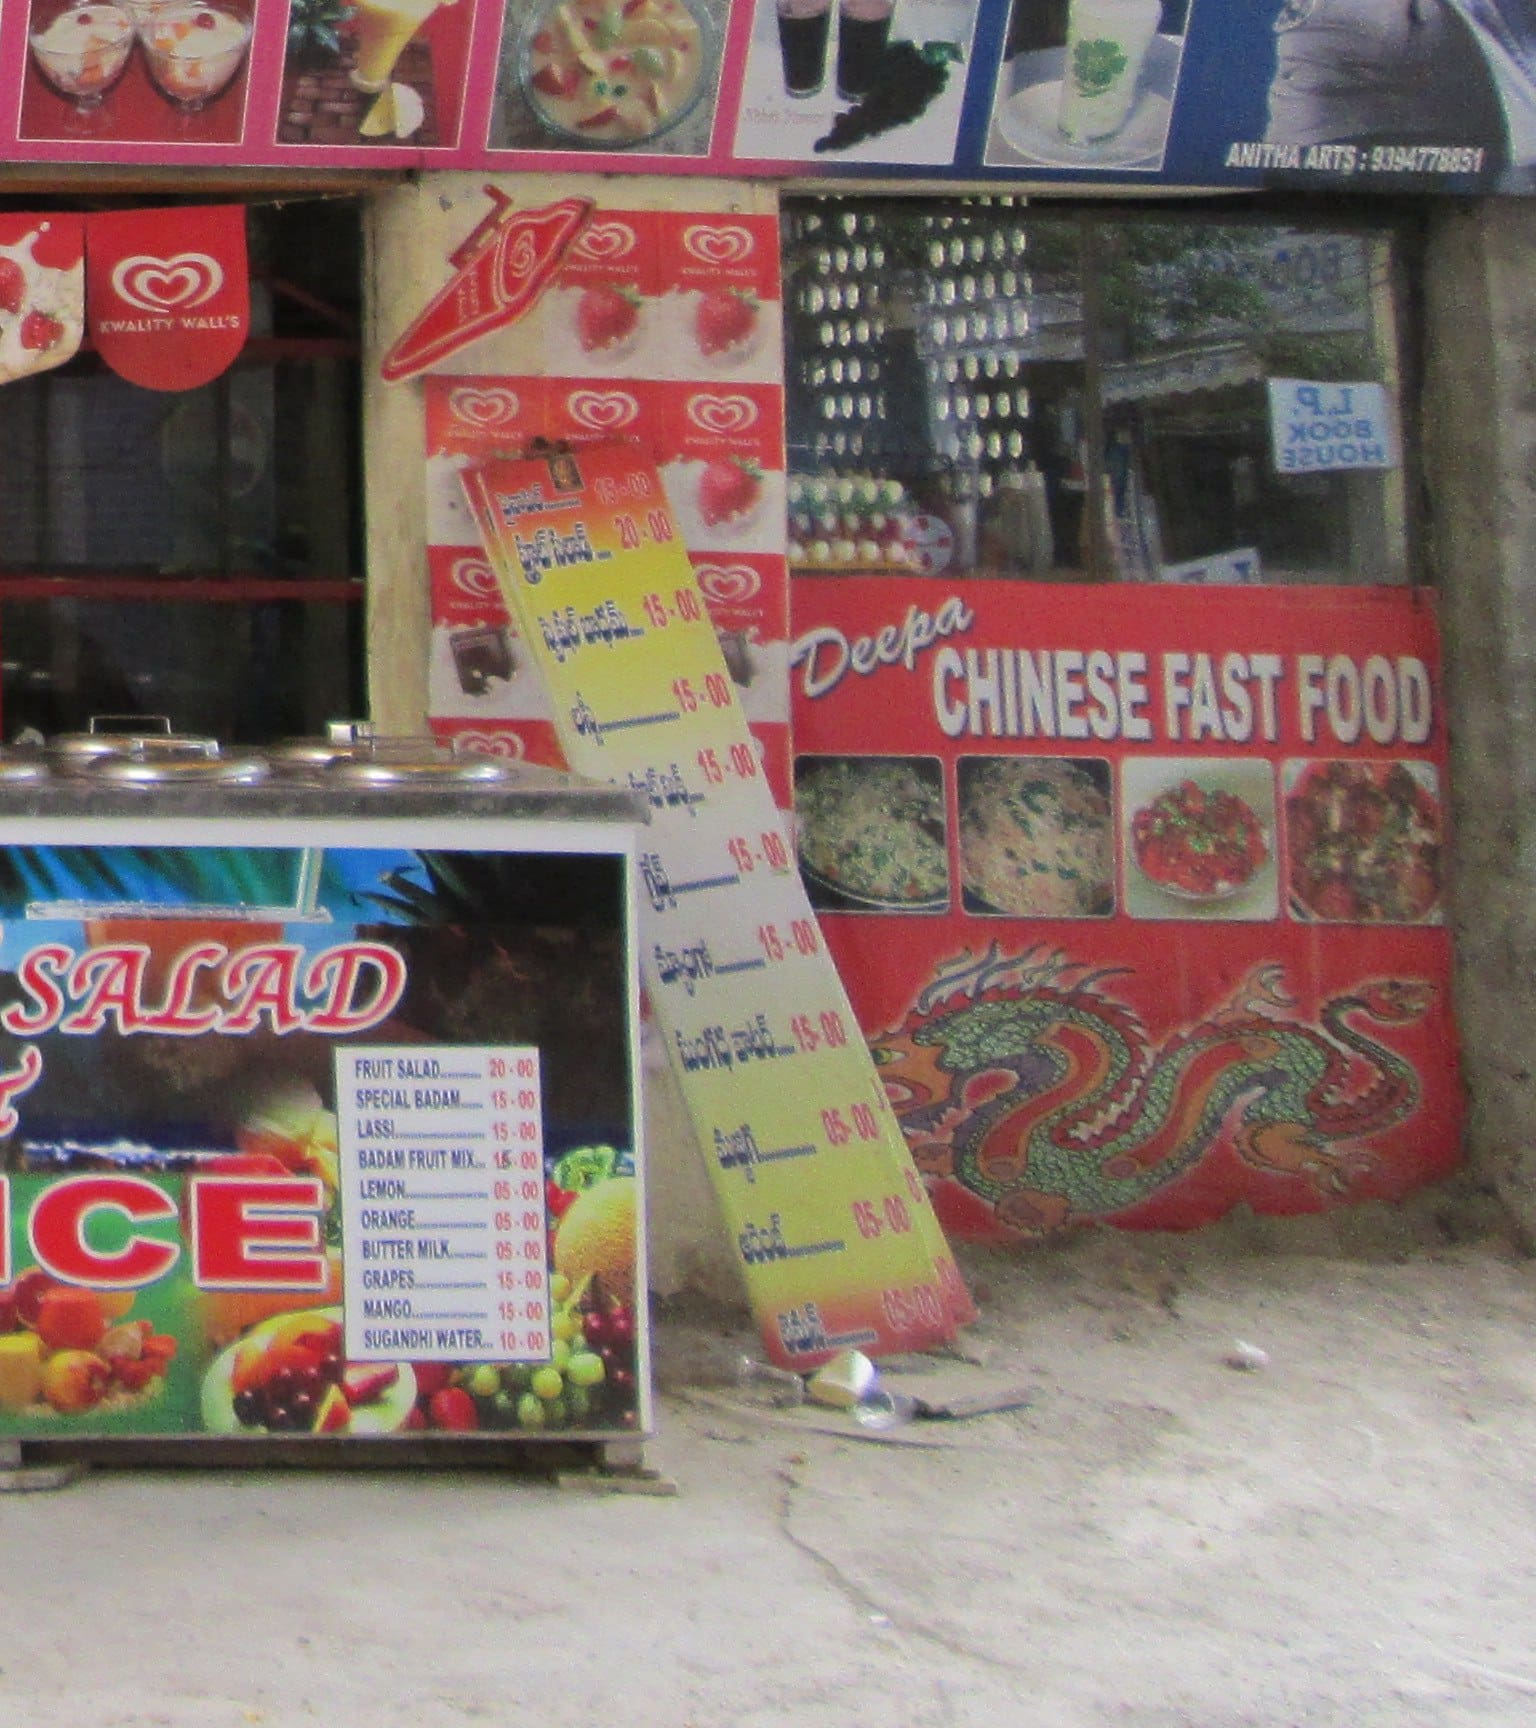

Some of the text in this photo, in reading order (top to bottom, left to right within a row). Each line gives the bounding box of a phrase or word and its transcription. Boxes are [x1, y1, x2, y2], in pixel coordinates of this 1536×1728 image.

[1226, 142, 1301, 170] ANITHA
[1306, 144, 1358, 174] ARTS
[99, 315, 242, 334] KWALITY WALL'S
[792, 596, 1432, 750] Deepa CHINESE FAST FOOD
[1, 939, 407, 1038] SALAD
[355, 1059, 394, 1079] FRUIT
[397, 1059, 441, 1079] SALAD
[356, 1088, 411, 1110] SPECIAL
[415, 1089, 462, 1110] BADAM
[357, 1119, 395, 1140] LASSI
[358, 1149, 405, 1170] BADAM
[408, 1149, 447, 1170] FRUIT
[451, 1149, 476, 1170] MIX
[360, 1179, 406, 1200] LEMON
[361, 1209, 416, 1230] ORANGE
[362, 1239, 415, 1260] BUTTER
[417, 1239, 450, 1260] MILK
[363, 1269, 415, 1290] GRAPES
[363, 1299, 413, 1320] MANGO
[364, 1328, 434, 1349] SUGANDHI
[436, 1328, 484, 1349] WATER
